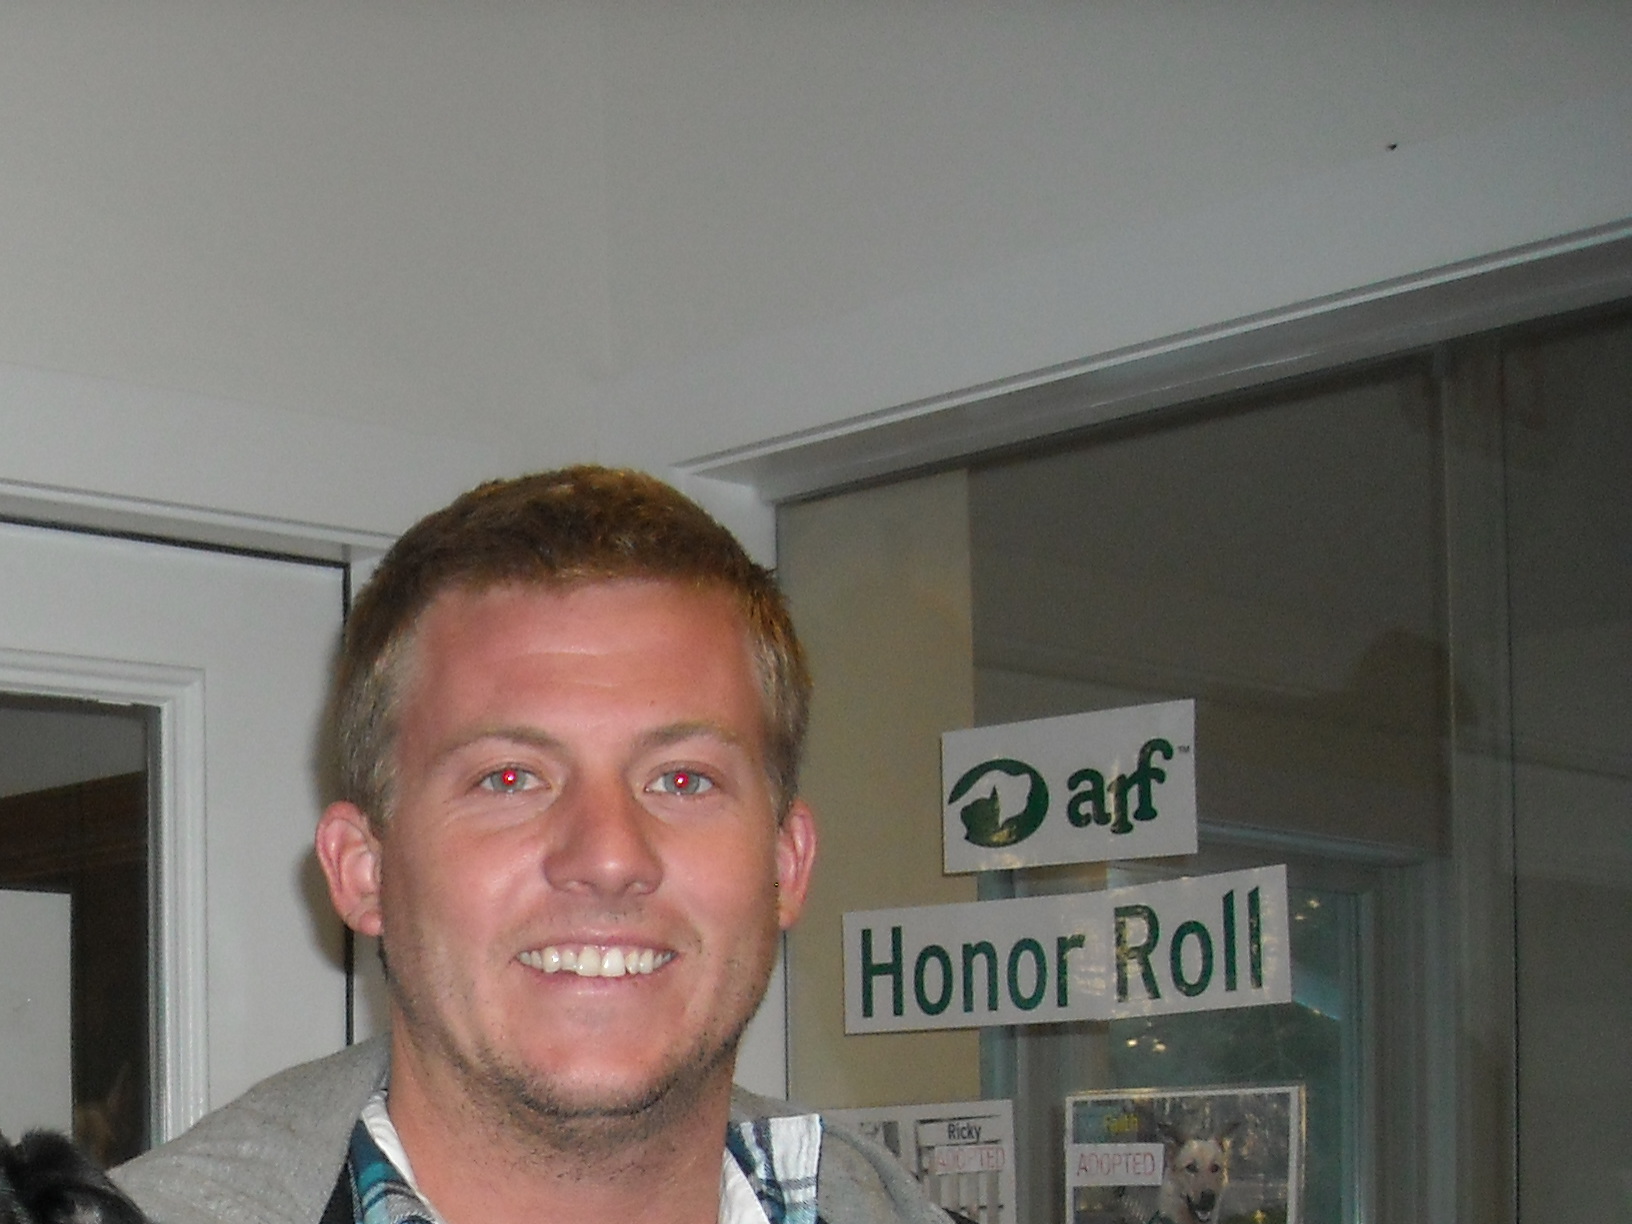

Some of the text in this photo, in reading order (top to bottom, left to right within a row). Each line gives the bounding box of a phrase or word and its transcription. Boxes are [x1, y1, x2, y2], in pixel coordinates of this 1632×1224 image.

[1067, 738, 1174, 834] arf
[861, 886, 1264, 1018] Honor Roll
[947, 1122, 982, 1143] Ricky
[1076, 1152, 1156, 1177] ADOPTED
